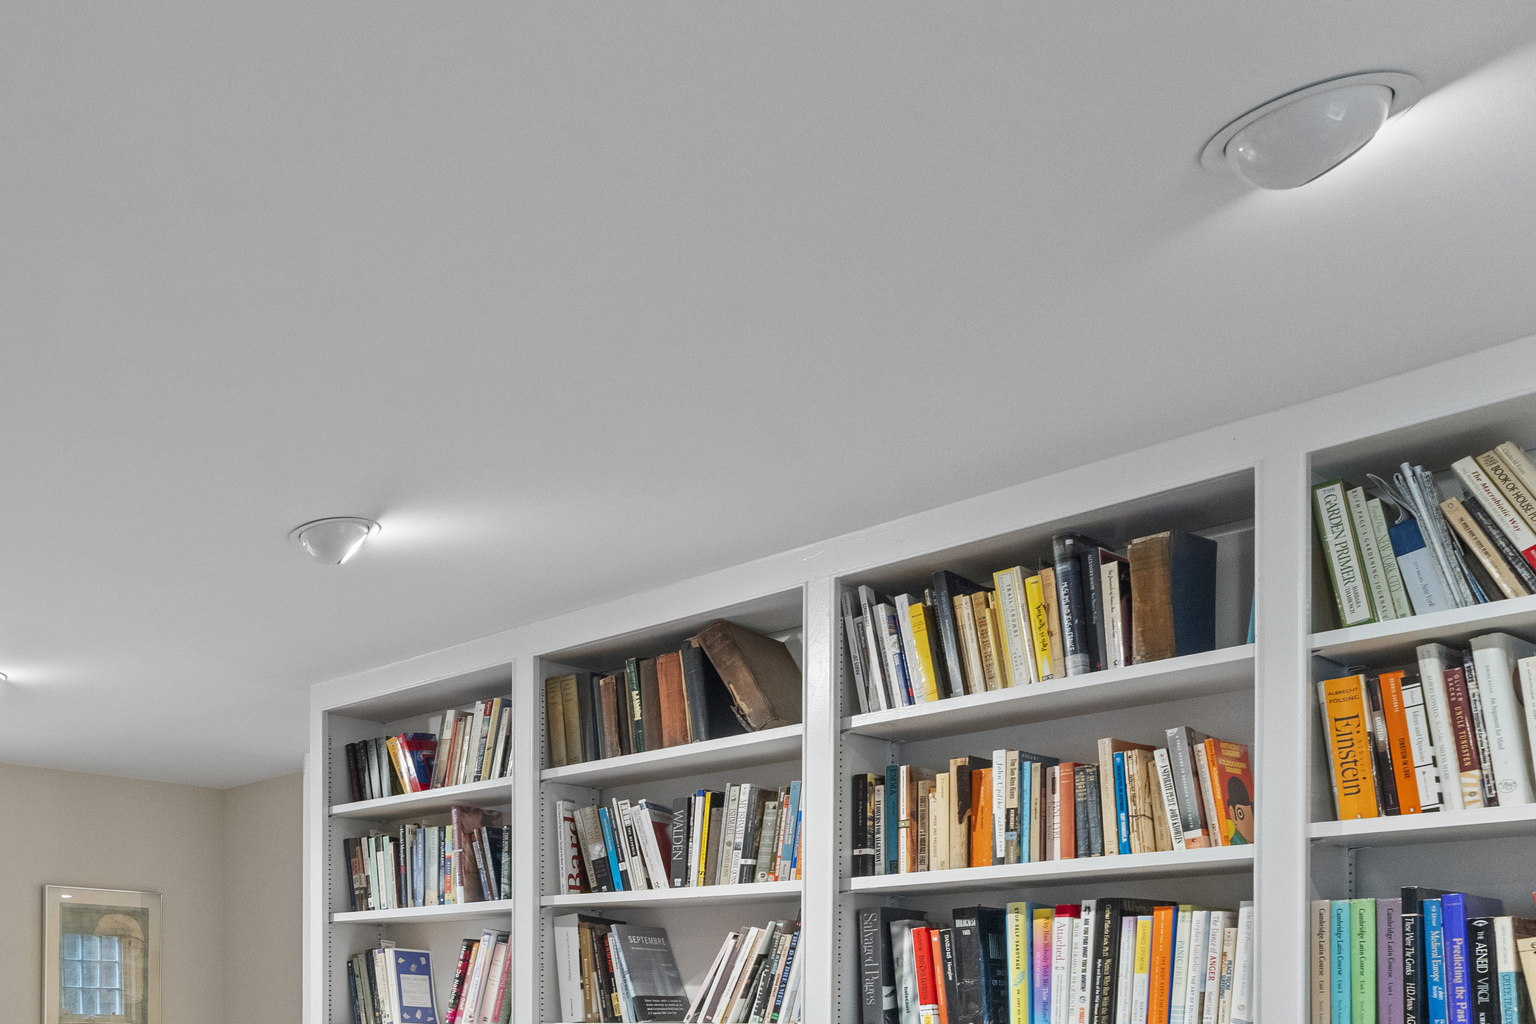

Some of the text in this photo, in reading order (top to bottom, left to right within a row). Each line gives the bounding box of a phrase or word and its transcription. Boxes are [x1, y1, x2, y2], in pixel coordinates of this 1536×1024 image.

[1471, 470, 1521, 532] The Macrobiotic Way
[1492, 464, 1532, 513] BOOK OF HOUSE
[1324, 494, 1356, 585] GARDEN PRIMER
[1351, 490, 1386, 613] RUTH PAGE'S GARDENING JOURNAL
[1377, 534, 1389, 551] NEW
[1382, 554, 1396, 574] YORK
[1352, 585, 1360, 608] BARBARA
[1388, 575, 1402, 593] CITY
[1454, 706, 1472, 766] UNCLE TUNGSTEN
[1334, 714, 1366, 797] Einstein
[672, 809, 685, 861] WALDEN
[628, 935, 666, 945] SEPTEMBRE
[1210, 928, 1219, 947] Dance
[1211, 916, 1219, 927] The
[1317, 908, 1325, 939] Cambridge
[459, 945, 467, 959] How
[863, 913, 879, 1005] Salvaged Pages
[1055, 921, 1066, 964] Attached.
[1208, 955, 1217, 981] ANGER
[1451, 938, 1467, 1023] Predicting the Past
[1475, 931, 1490, 1004] THE AENEID VIRGIL
[449, 979, 459, 1003] Nothing
